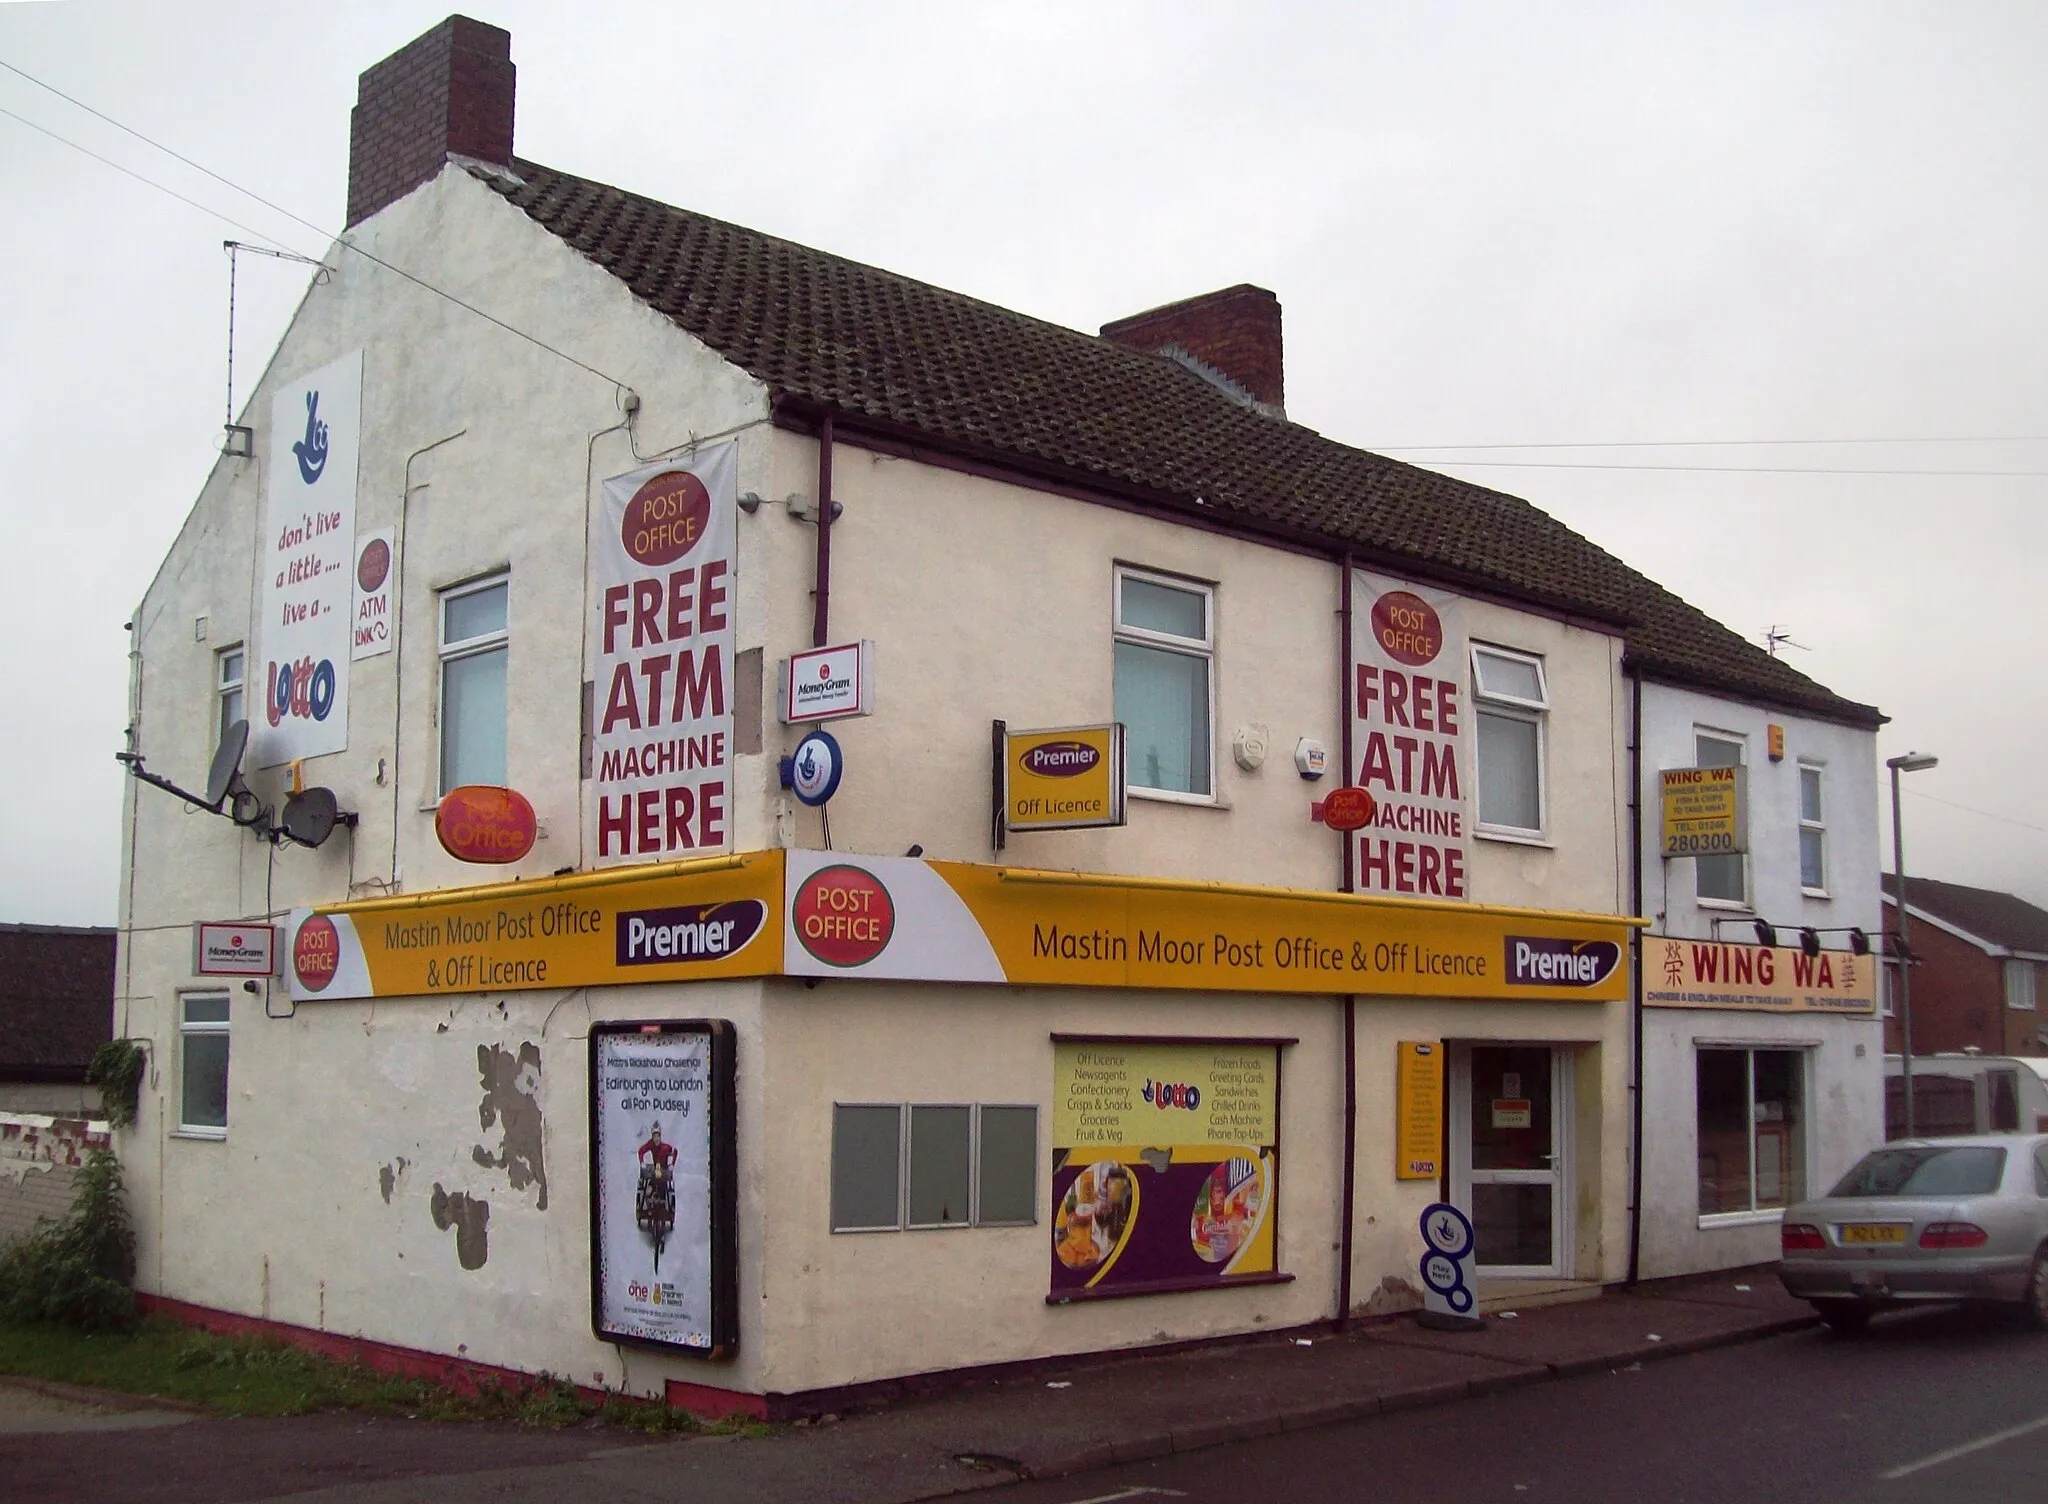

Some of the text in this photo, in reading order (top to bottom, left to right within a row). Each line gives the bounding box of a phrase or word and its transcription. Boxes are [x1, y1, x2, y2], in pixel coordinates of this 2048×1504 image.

[643, 489, 687, 524] POST
[278, 511, 341, 551] don't live
[634, 516, 696, 555] OFFICE
[275, 570, 284, 589] a
[288, 553, 321, 585] little
[282, 599, 307, 627] live
[310, 599, 319, 618] a
[359, 593, 386, 621] ATM
[601, 558, 728, 655] FREE
[1390, 605, 1426, 631] POST
[1383, 628, 1433, 657] OFFICE
[600, 644, 726, 735] ATM
[798, 678, 851, 696] MoneyGram
[1355, 662, 1460, 737] FREE
[599, 731, 726, 784] MACHINE
[1033, 748, 1096, 767] Premier
[1357, 730, 1461, 801] ATM
[1664, 768, 1734, 785] WING WA
[466, 800, 515, 821] Post
[1017, 798, 1101, 816] Off Licence
[598, 780, 726, 858] HERE
[452, 822, 524, 849] Office
[1668, 831, 1732, 853] 280300
[1359, 837, 1464, 898] HERE
[817, 887, 874, 912] POST
[385, 902, 602, 950] Mastin Moor Post Office
[628, 914, 736, 959] Premier
[804, 914, 881, 942] OFFICE
[302, 930, 331, 949] POST
[1033, 923, 1487, 976] Mastin Moor Post Office & Off Licence
[208, 947, 264, 958] MoneyGram
[297, 950, 334, 972] OFFICE
[1515, 941, 1600, 982] Premier
[426, 954, 547, 988] & Off Licence
[1691, 944, 1834, 989] WING WA
[1077, 1052, 1125, 1066] Off Licence
[1213, 1056, 1262, 1070] Frozen Foods
[655, 1077, 668, 1091] to
[668, 1078, 704, 1092] London
[1074, 1068, 1127, 1083] Newsagents
[1209, 1071, 1265, 1086] Greeting Cards
[1070, 1083, 1130, 1099] Confectionery
[1215, 1085, 1259, 1097] Sandwiches
[633, 1098, 651, 1110] for
[1067, 1098, 1133, 1113] Crisps & Snacks
[1211, 1099, 1261, 1112] Chilled Drinks
[1080, 1113, 1120, 1126] Groceries
[1209, 1113, 1263, 1126] Cash Machine
[1076, 1128, 1123, 1144] Fruit & Veg
[1207, 1127, 1264, 1142] Phone Top-Ups
[1432, 1271, 1451, 1281] here
[628, 1284, 649, 1298] one
